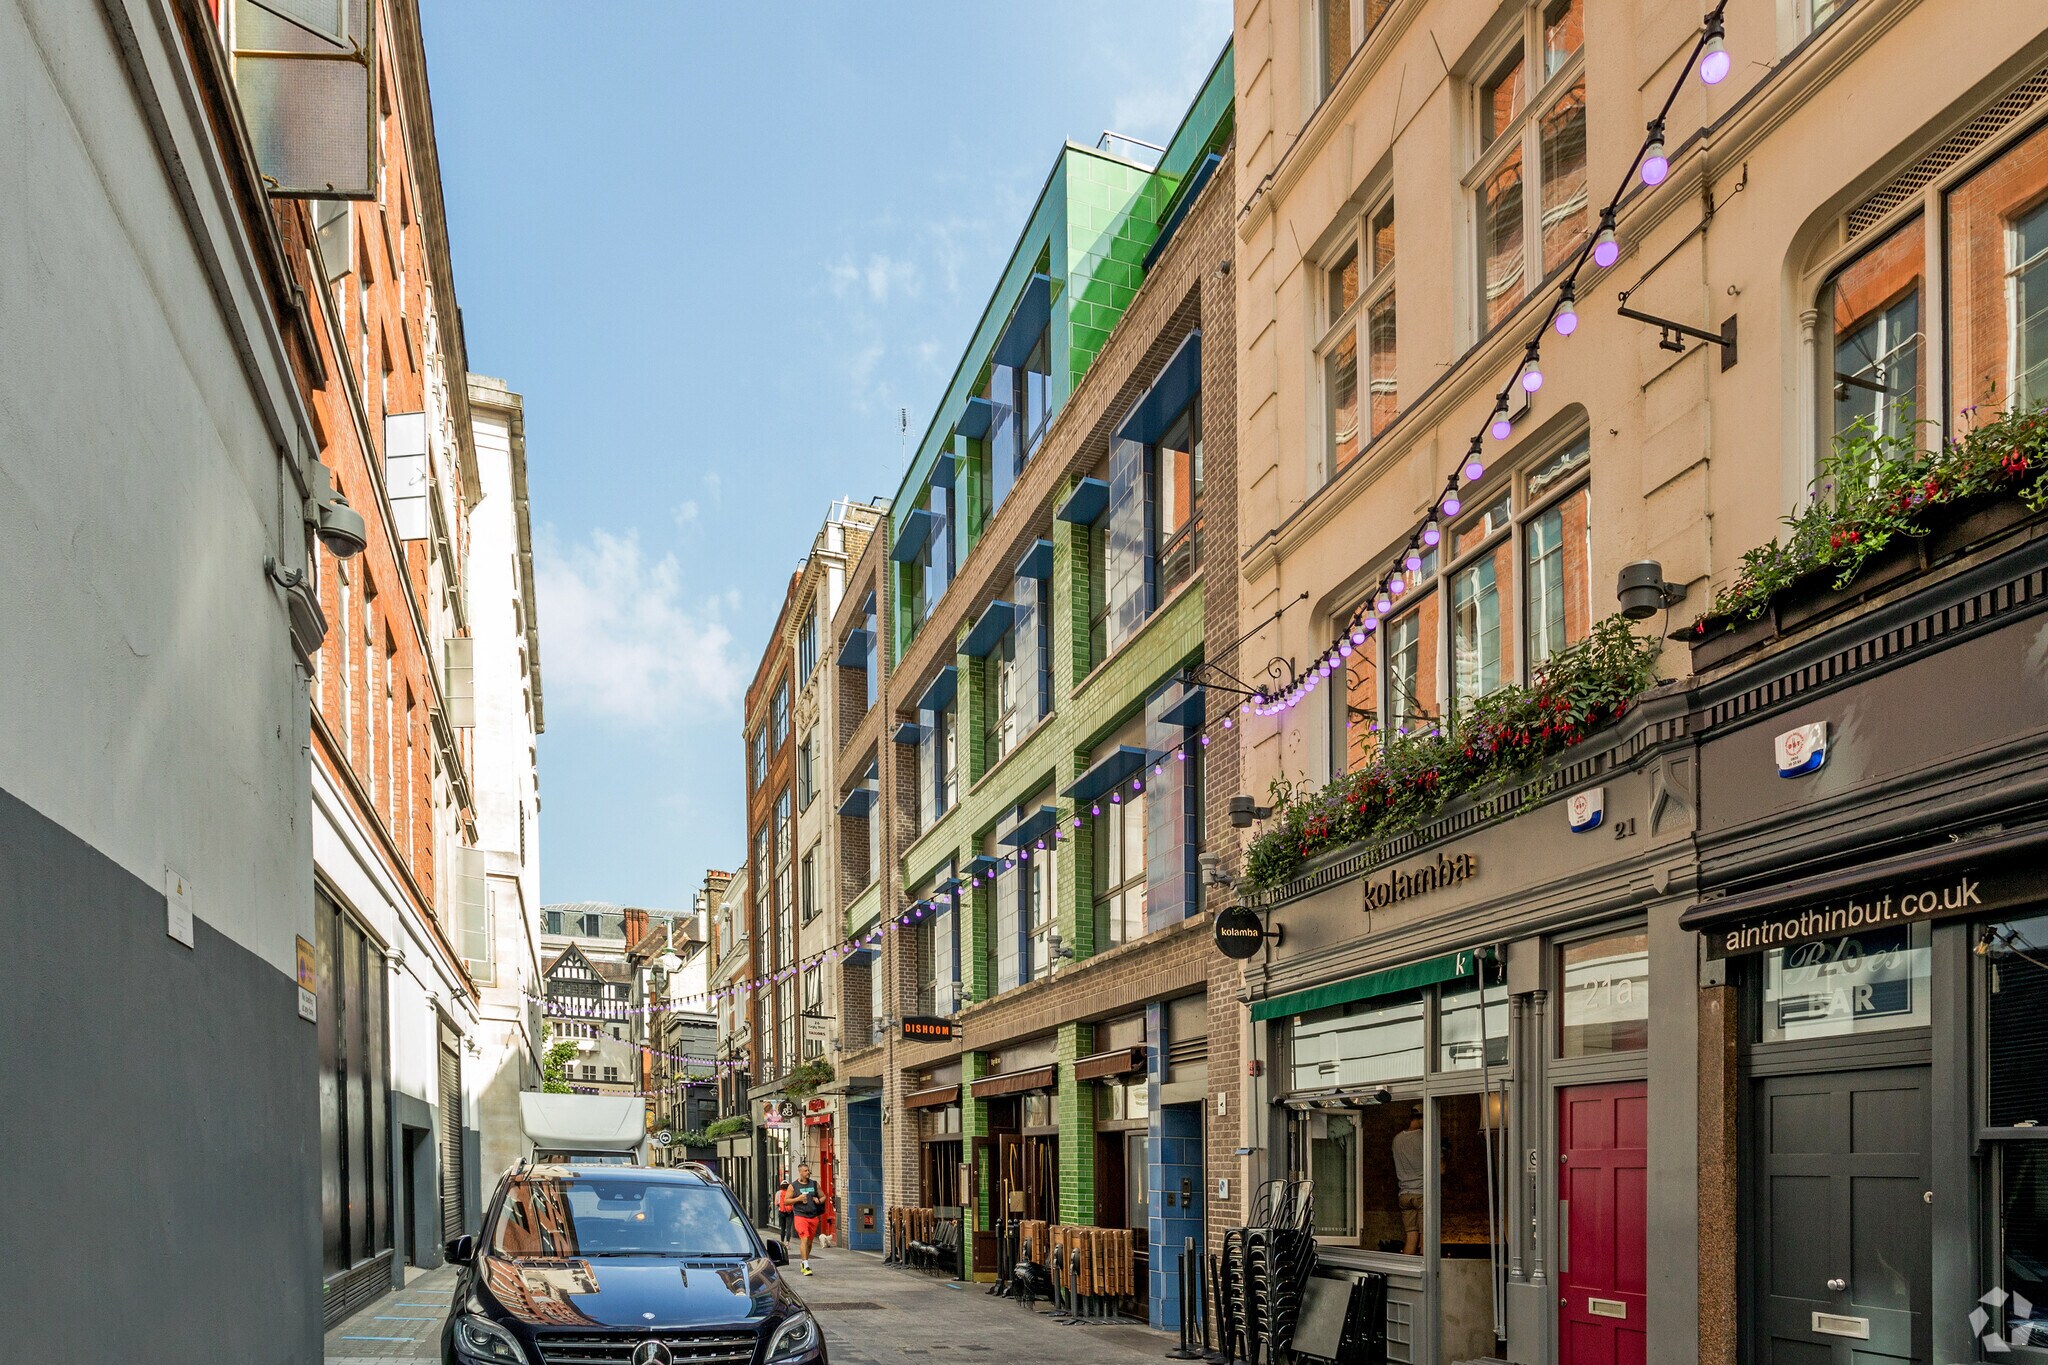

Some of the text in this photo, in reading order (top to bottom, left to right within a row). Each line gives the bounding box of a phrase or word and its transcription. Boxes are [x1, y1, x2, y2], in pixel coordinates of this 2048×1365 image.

[1614, 817, 1637, 840] 21
[1363, 853, 1475, 912] kolamba
[1726, 877, 1981, 950] aintnothinbut.co.uk
[1221, 927, 1259, 937] kolamba
[1455, 952, 1466, 976] k
[1583, 975, 1634, 1009] 21a
[1808, 983, 1876, 1018] BAR
[905, 1023, 949, 1035] DISHOOM
